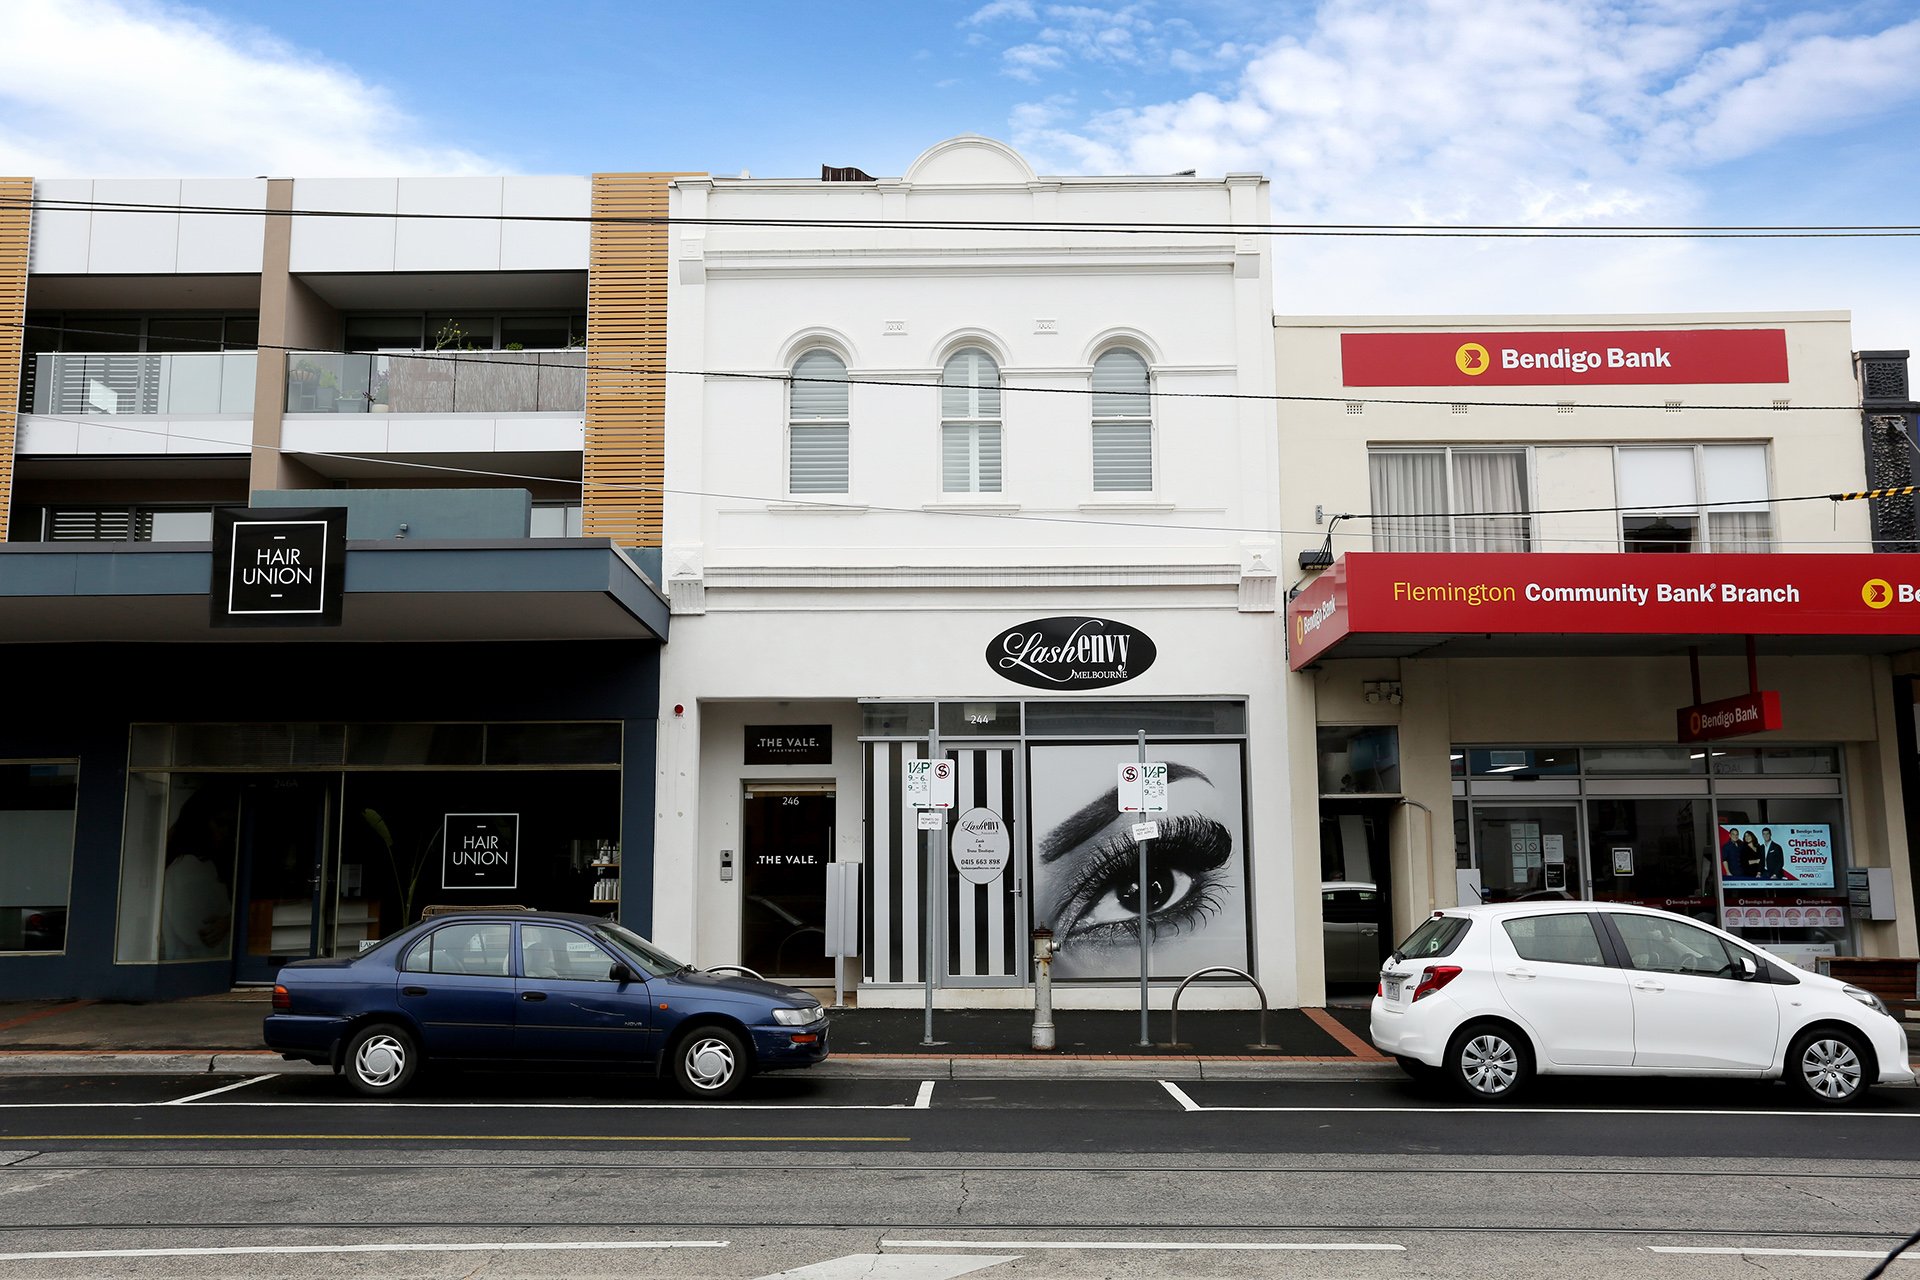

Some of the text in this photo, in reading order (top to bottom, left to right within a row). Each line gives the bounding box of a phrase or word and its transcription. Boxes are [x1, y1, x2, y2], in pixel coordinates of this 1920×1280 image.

[1501, 348, 1672, 372] Bendigo Bank
[257, 548, 300, 565] HAIR
[243, 568, 312, 584] UNION
[1393, 582, 1516, 606] Flemington
[1525, 583, 1649, 606] Community
[1721, 584, 1800, 602] Branch
[1303, 594, 1336, 634] Bendigo Bank
[1074, 670, 1128, 679] MELBOURNE
[970, 714, 990, 724] 244
[1701, 705, 1758, 729] Bendigo Bank
[782, 796, 800, 806] 246
[464, 836, 498, 849] HAIR
[453, 851, 508, 865] UNION
[1790, 855, 1828, 864] Browny
